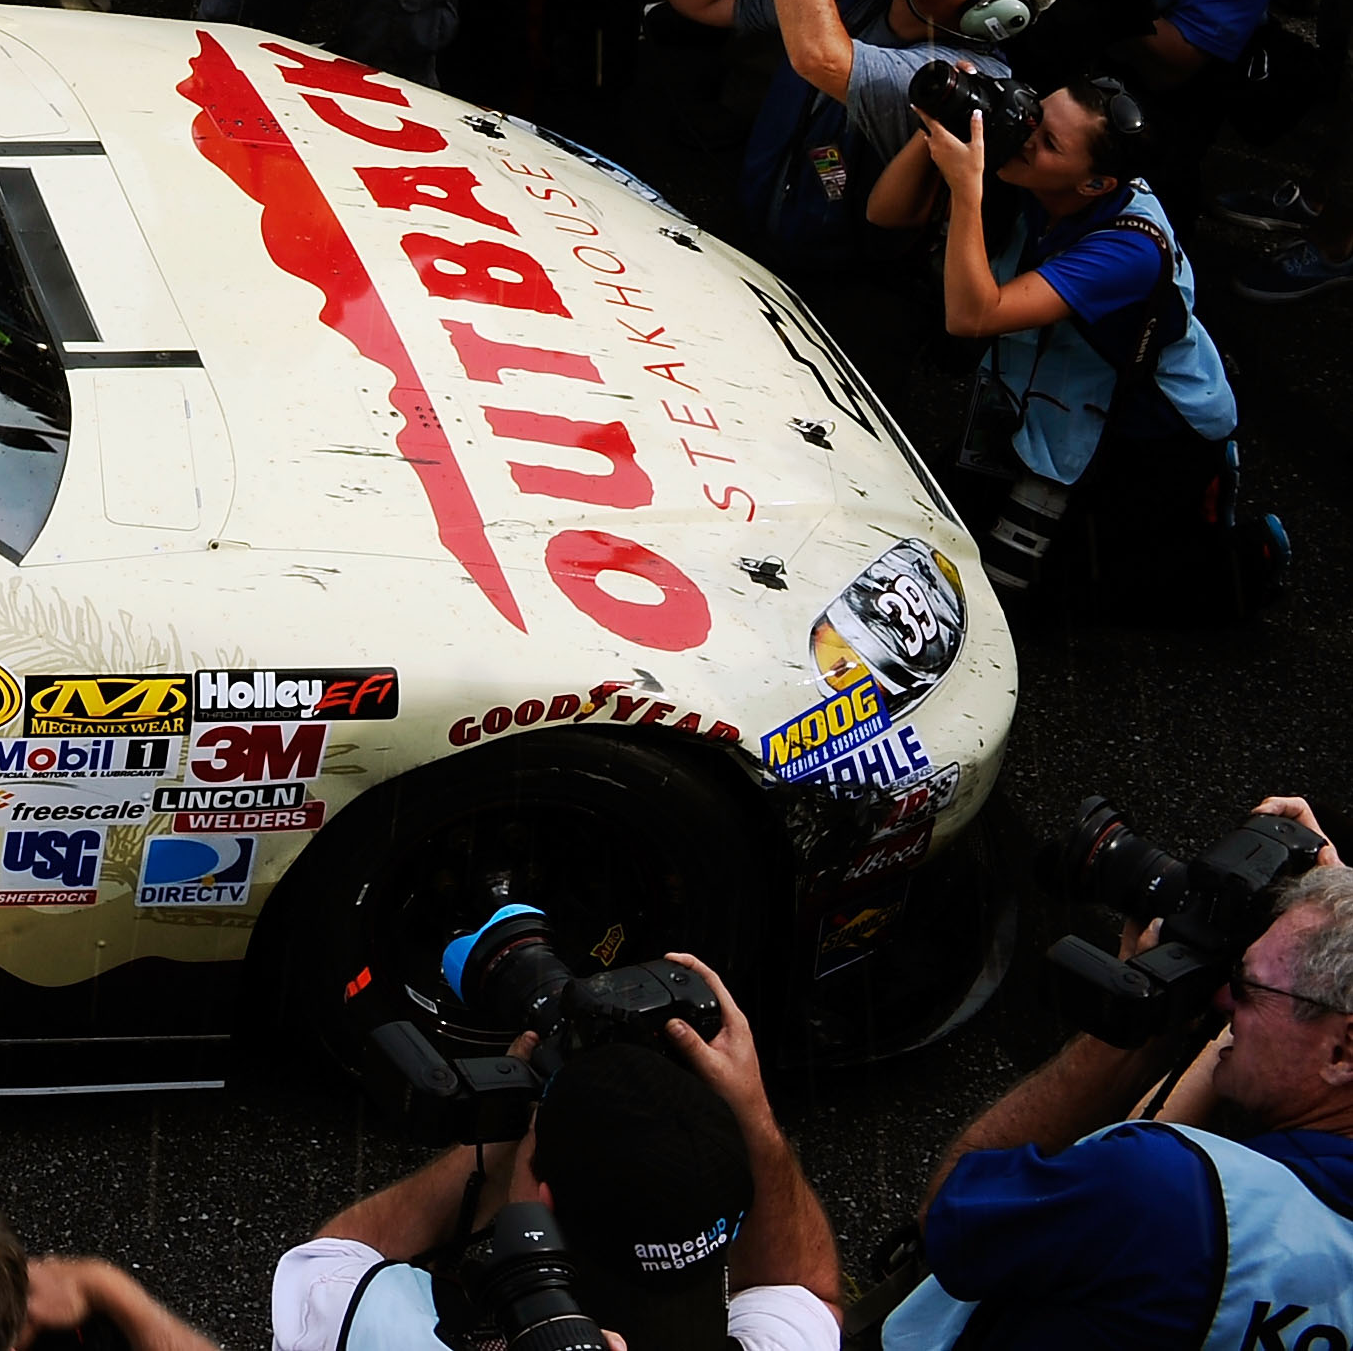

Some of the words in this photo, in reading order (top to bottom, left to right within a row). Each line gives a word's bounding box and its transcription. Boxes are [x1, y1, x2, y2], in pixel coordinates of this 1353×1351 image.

[257, 40, 713, 652] OUTBACK
[510, 157, 757, 523] STEAKHOUSE
[877, 574, 941, 658] 39
[199, 671, 323, 716] Holley
[31, 718, 128, 735] MECHANIX
[132, 717, 185, 733] WEAR
[768, 678, 879, 768] MOOG
[831, 714, 885, 756] SUSPENSION
[32, 771, 70, 780] MOTOR
[71, 770, 87, 779] OIL
[100, 769, 165, 778] LUBRICANTS
[191, 723, 327, 784] 3M
[10, 800, 147, 822] freescale
[160, 786, 297, 810] LINCOLN
[188, 810, 306, 831] WELDERS
[2, 829, 101, 888] USG
[641, 1233, 728, 1271] magazine
